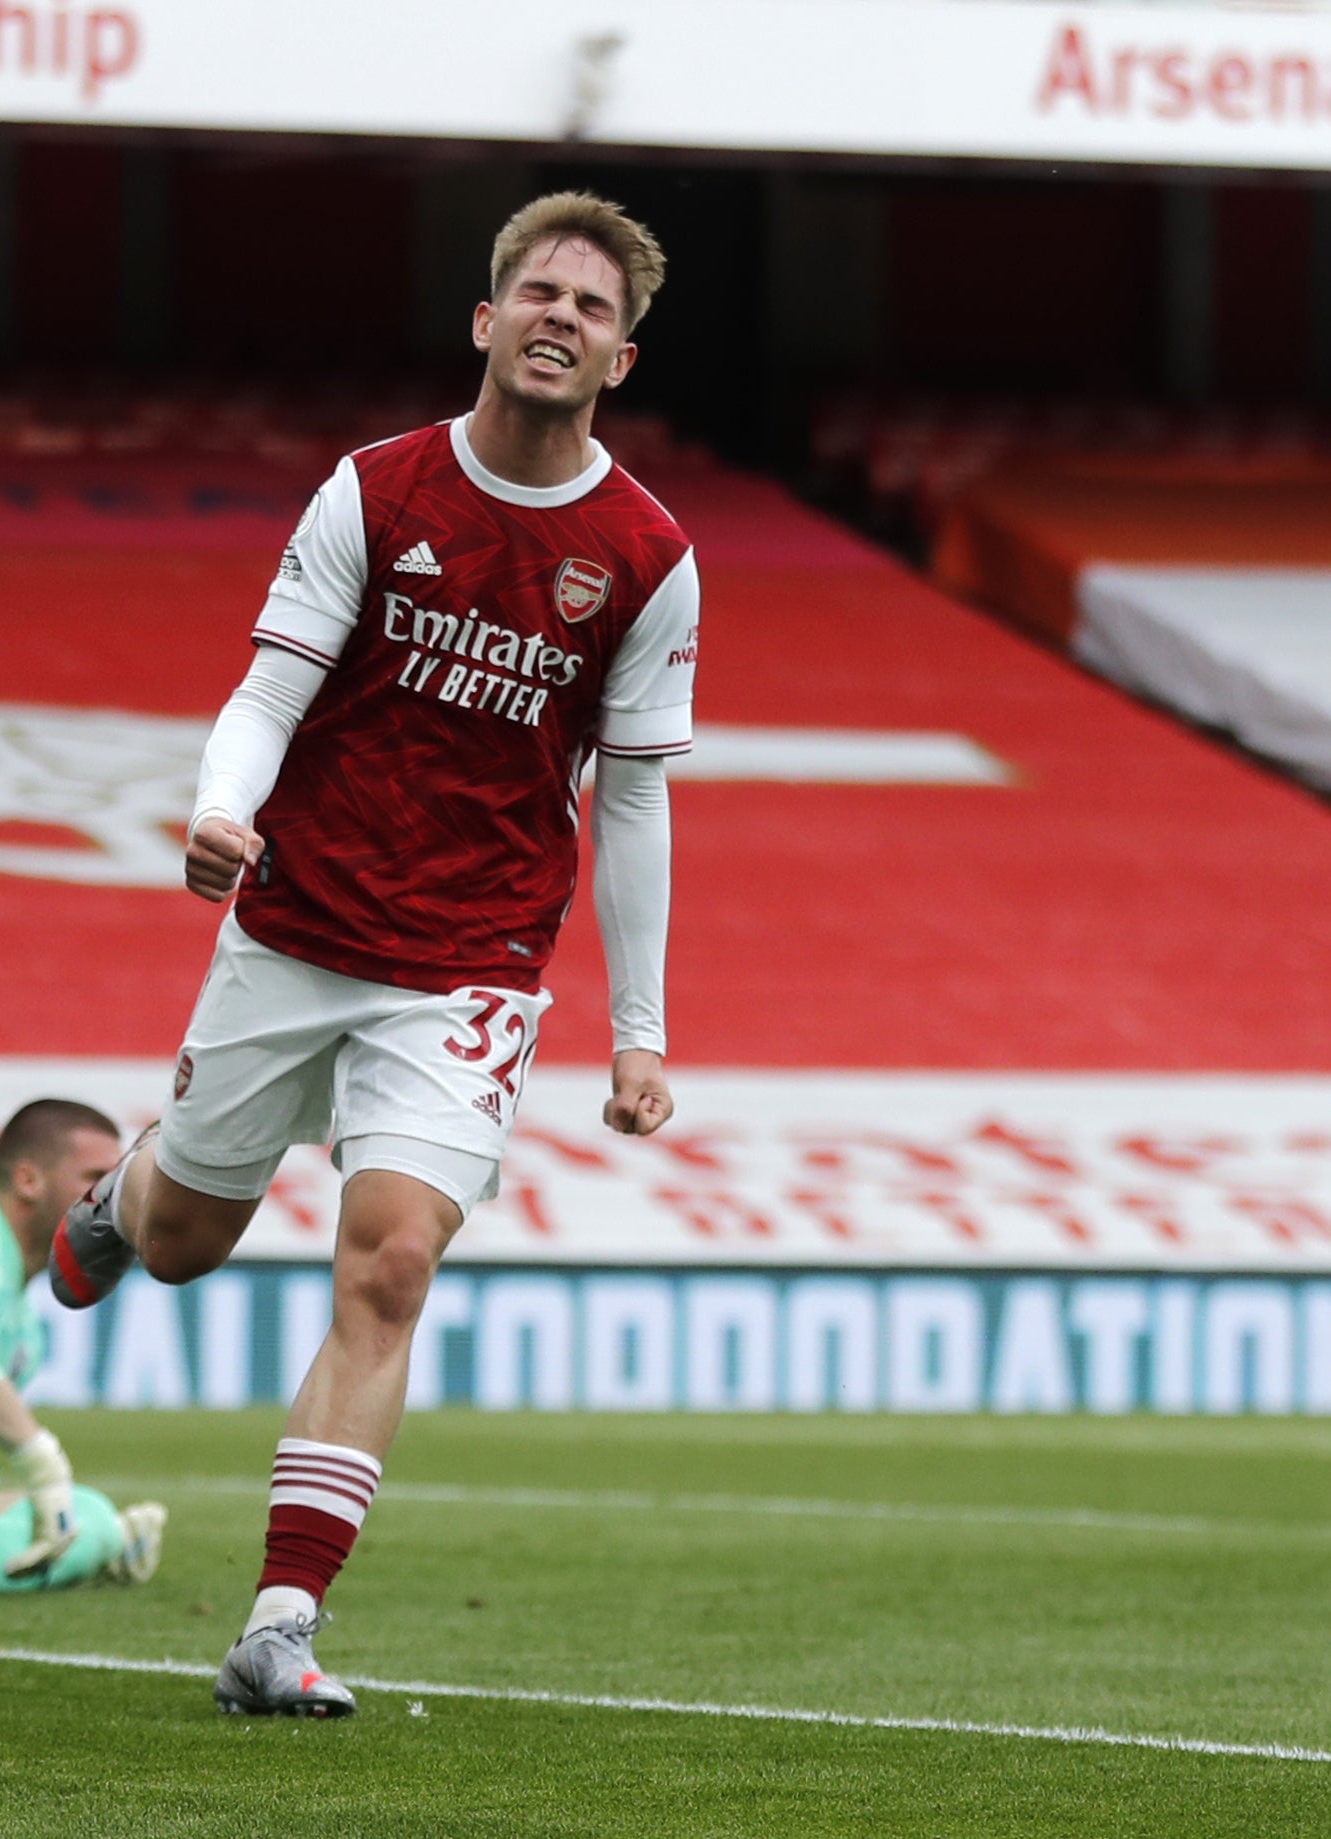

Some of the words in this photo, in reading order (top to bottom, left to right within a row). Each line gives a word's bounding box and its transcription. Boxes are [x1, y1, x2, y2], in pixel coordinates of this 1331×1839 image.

[1032, 25, 1331, 122] Arsen
[392, 558, 443, 576] adidas
[383, 591, 584, 686] Emirates
[437, 663, 549, 727] BETTER
[442, 989, 525, 1099] 32
